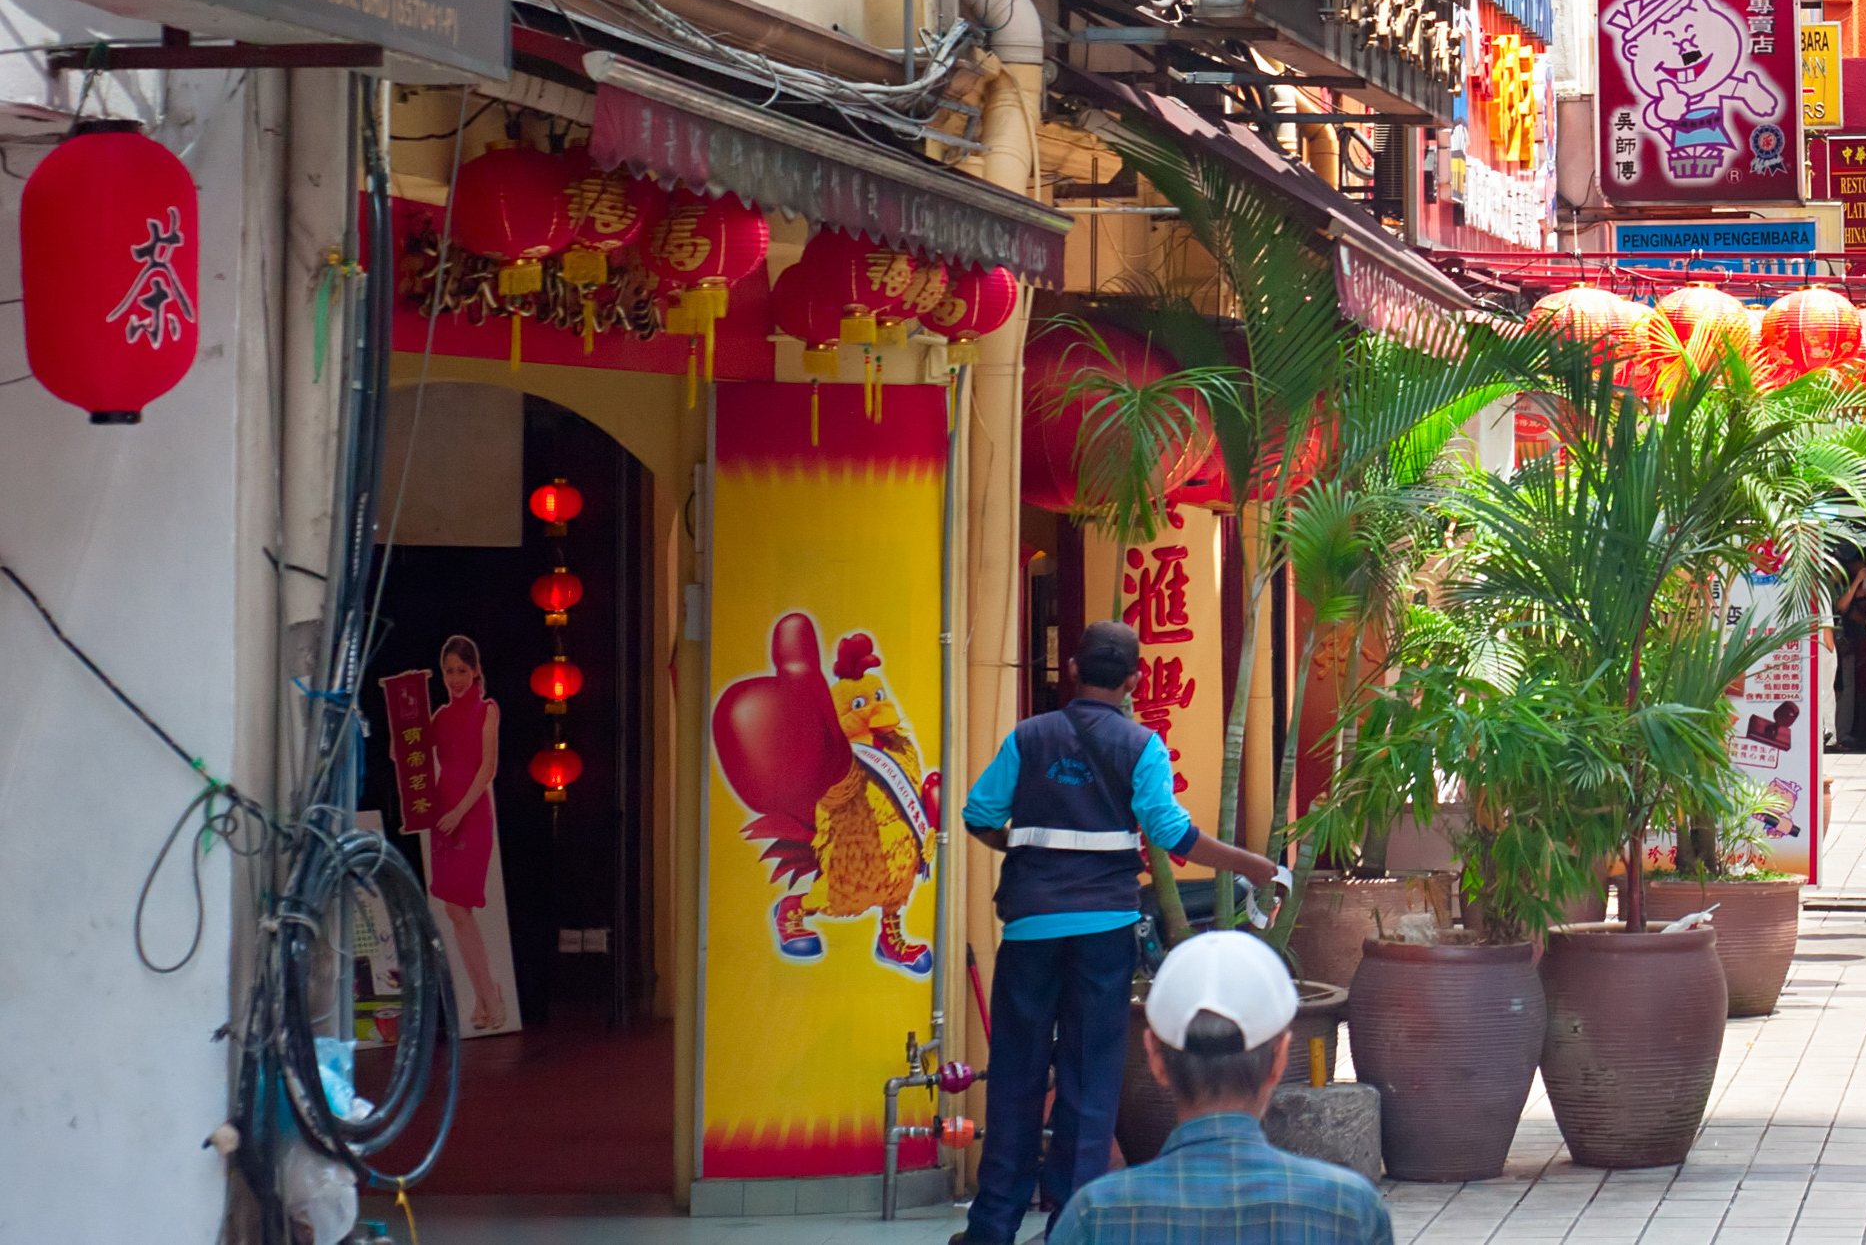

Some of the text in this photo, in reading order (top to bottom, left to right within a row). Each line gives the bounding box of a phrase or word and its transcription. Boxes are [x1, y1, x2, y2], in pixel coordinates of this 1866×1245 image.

[106, 206, 195, 350] 茶
[1622, 227, 1809, 248] PENGINAPAN PENGEMBARA
